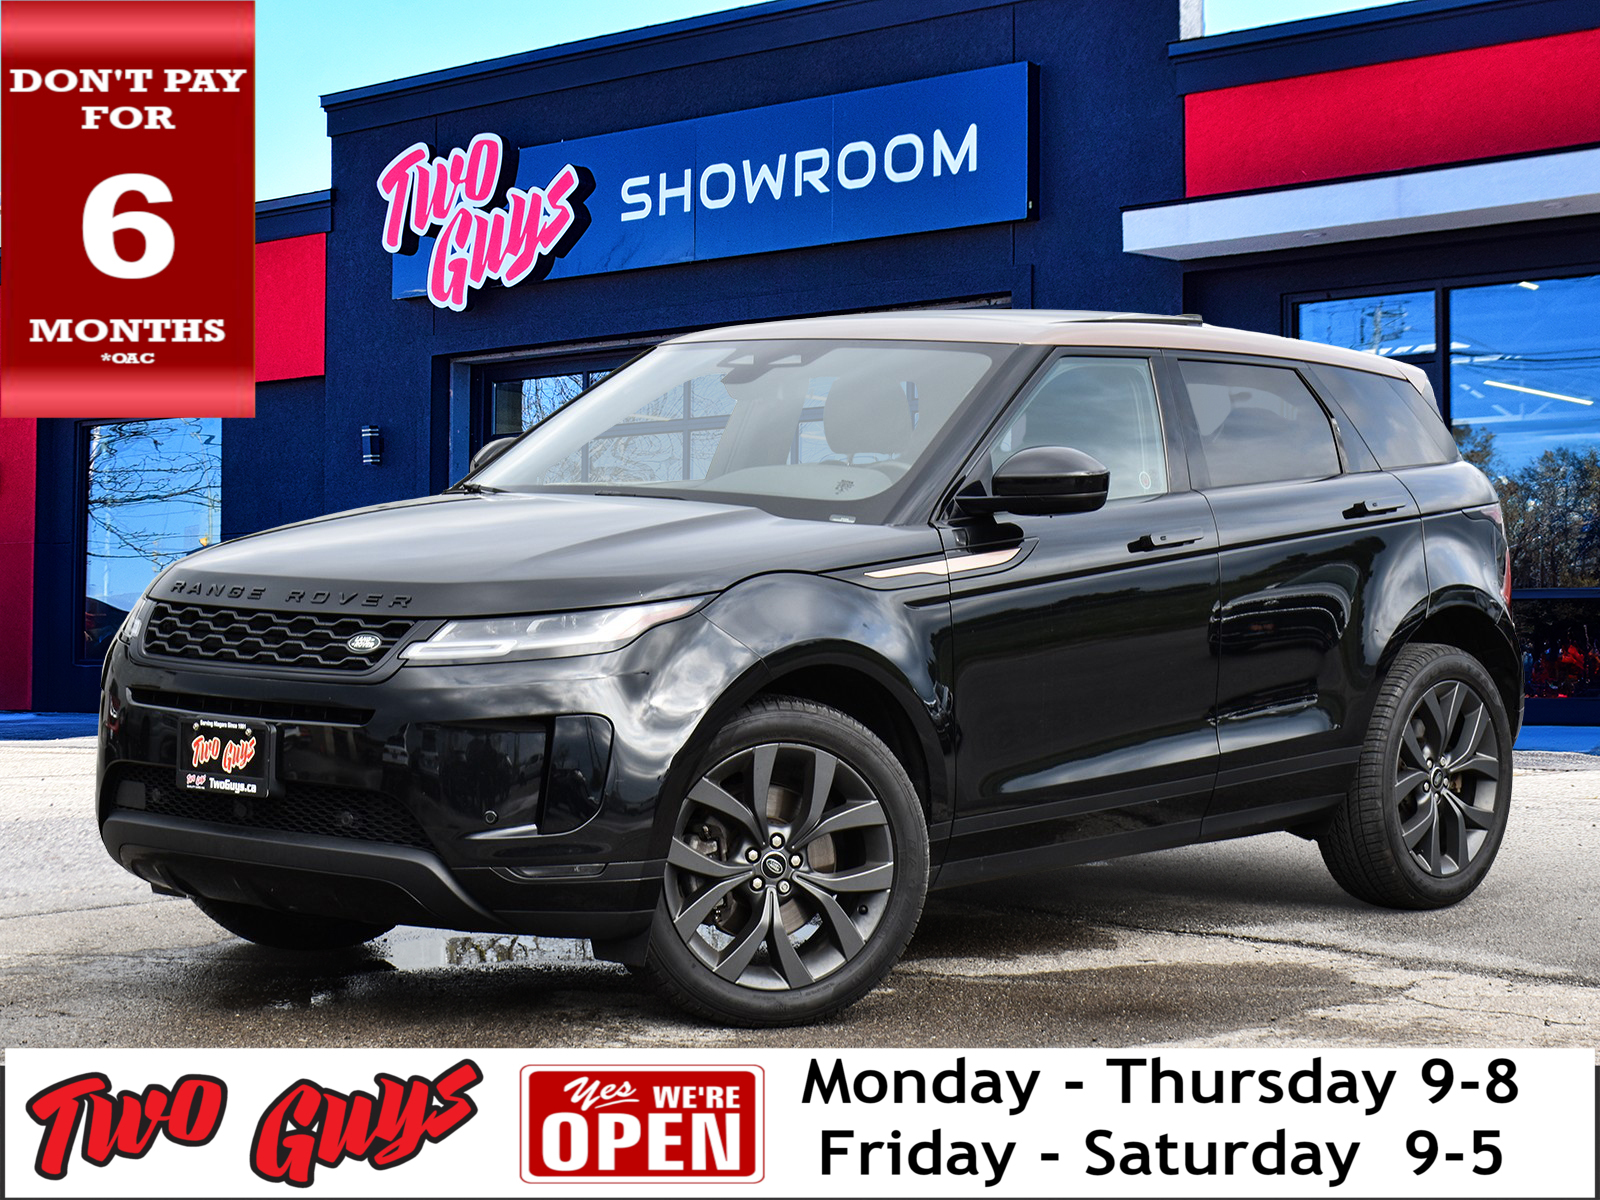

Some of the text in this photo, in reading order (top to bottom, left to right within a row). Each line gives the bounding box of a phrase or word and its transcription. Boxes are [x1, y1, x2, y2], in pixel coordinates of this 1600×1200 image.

[377, 132, 503, 254] Two
[620, 123, 977, 222] SHOWROOM
[426, 163, 579, 312] Guys
[170, 580, 413, 608] RANGE ROVER
[192, 735, 256, 774] Two Guys
[209, 777, 257, 794] TwoGuys.ca
